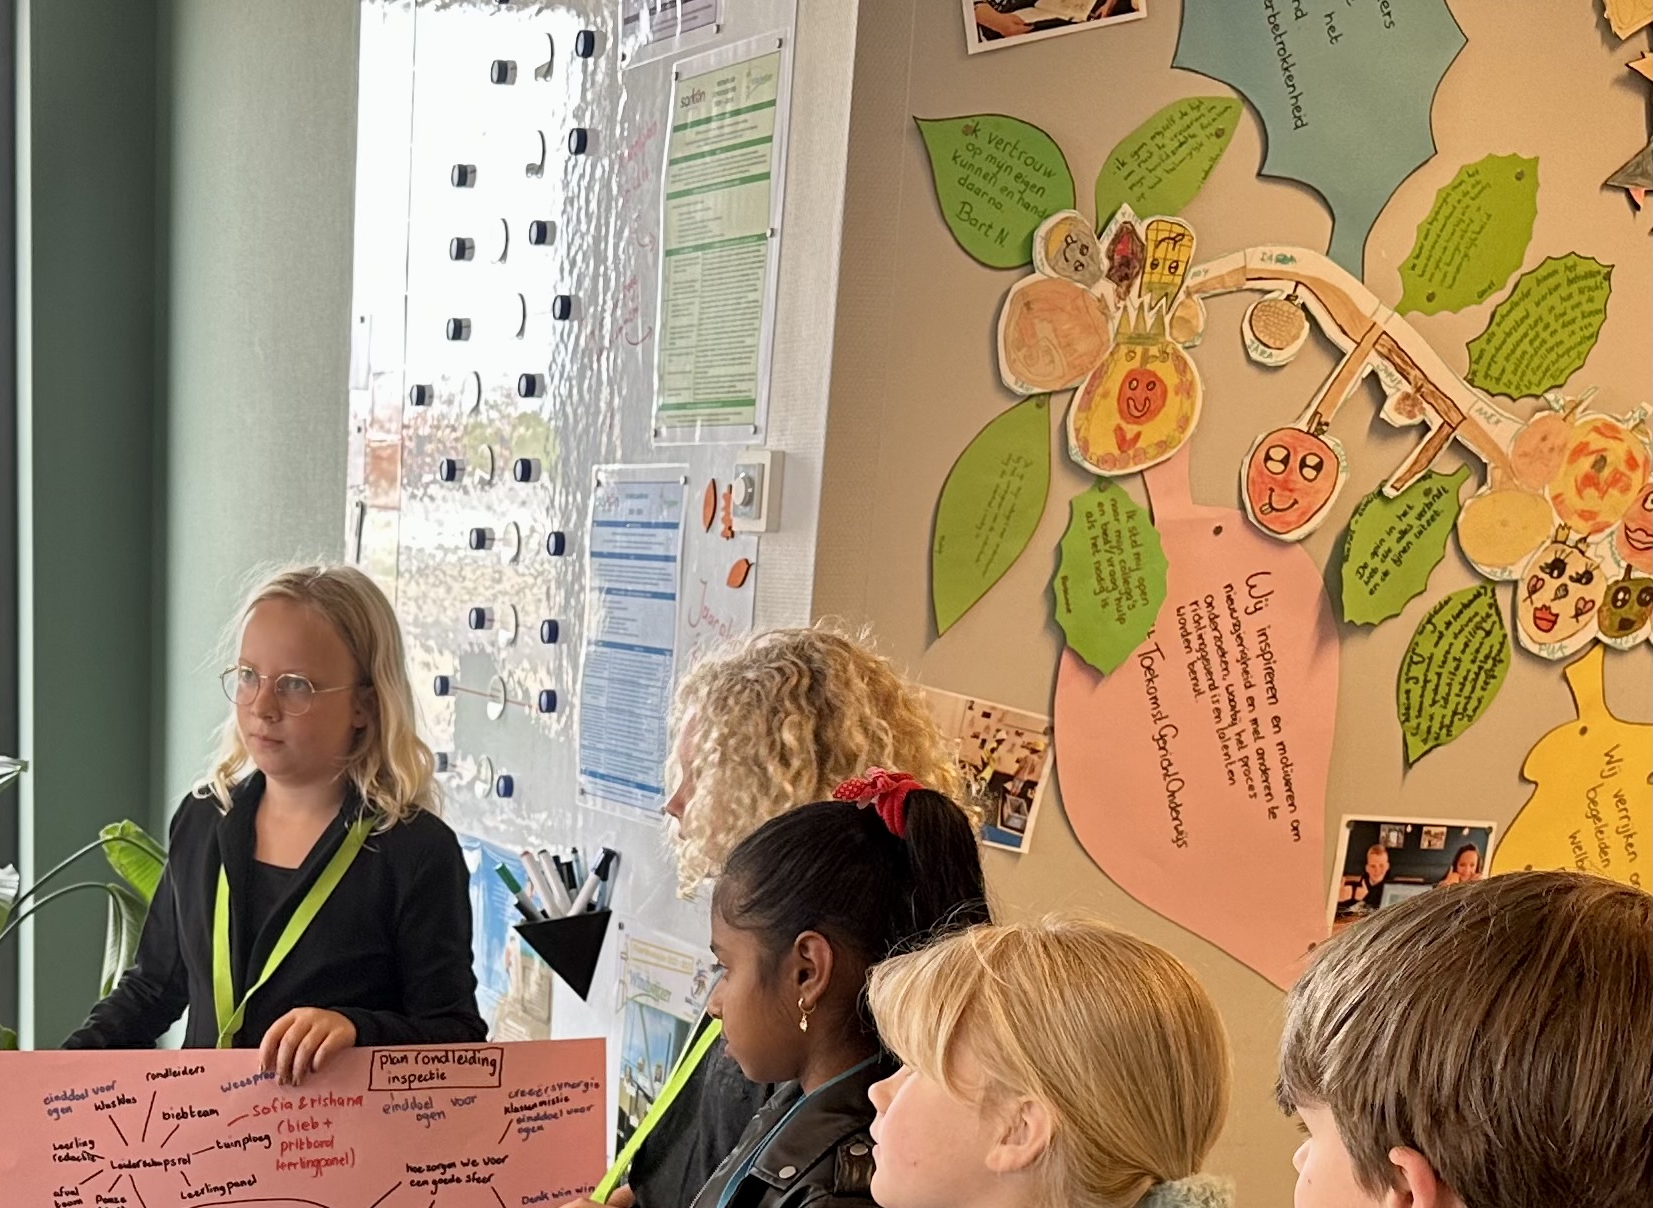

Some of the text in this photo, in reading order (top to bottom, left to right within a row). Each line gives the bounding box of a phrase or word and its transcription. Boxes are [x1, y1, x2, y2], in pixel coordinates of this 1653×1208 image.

[965, 142, 983, 159] op
[987, 132, 1057, 179] vertrouw
[951, 149, 998, 187] kunnen
[955, 201, 994, 238] Bart
[1255, 624, 1280, 706] inspireren
[1270, 714, 1283, 735] en
[1245, 695, 1256, 714] en
[379, 1049, 498, 1077] plan rondleiding
[387, 1068, 447, 1090] inspectie
